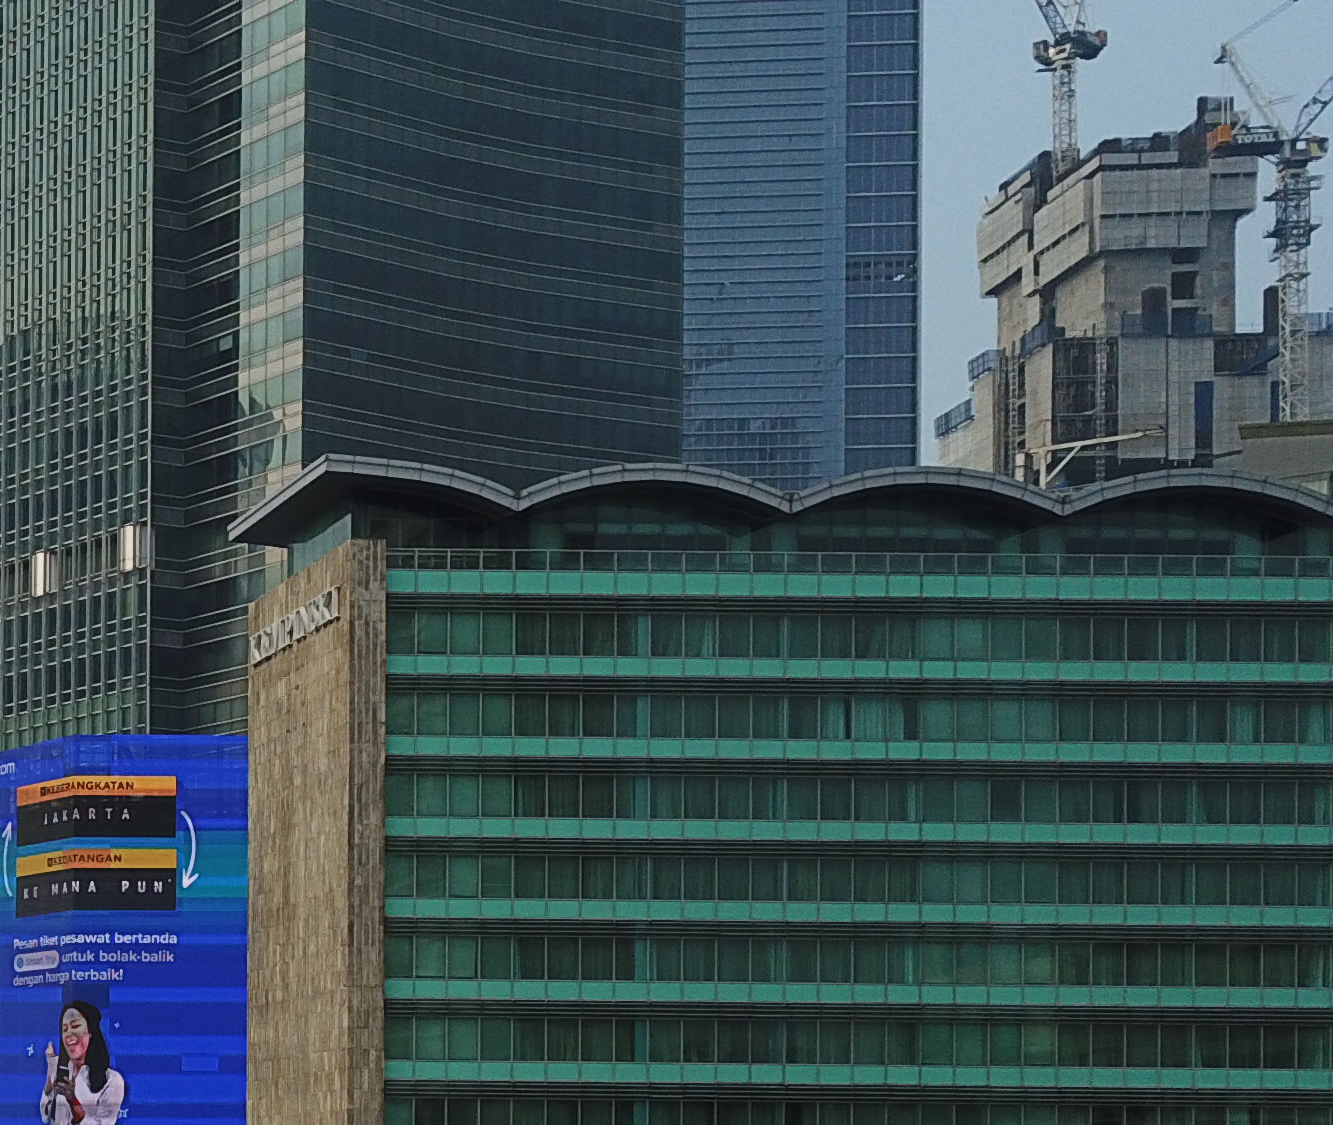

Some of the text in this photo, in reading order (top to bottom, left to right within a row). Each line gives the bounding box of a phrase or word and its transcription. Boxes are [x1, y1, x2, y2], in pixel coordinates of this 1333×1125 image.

[1236, 133, 1277, 144] TOTAL
[43, 807, 131, 825] JAKARTA
[23, 885, 39, 900] KE
[51, 879, 97, 896] MANA
[13, 932, 178, 950] Pesan tiket pesawat bertanda
[61, 949, 95, 963] untuk
[99, 949, 174, 963] bolak-balik
[13, 969, 124, 987] dengan harga terbaik!
